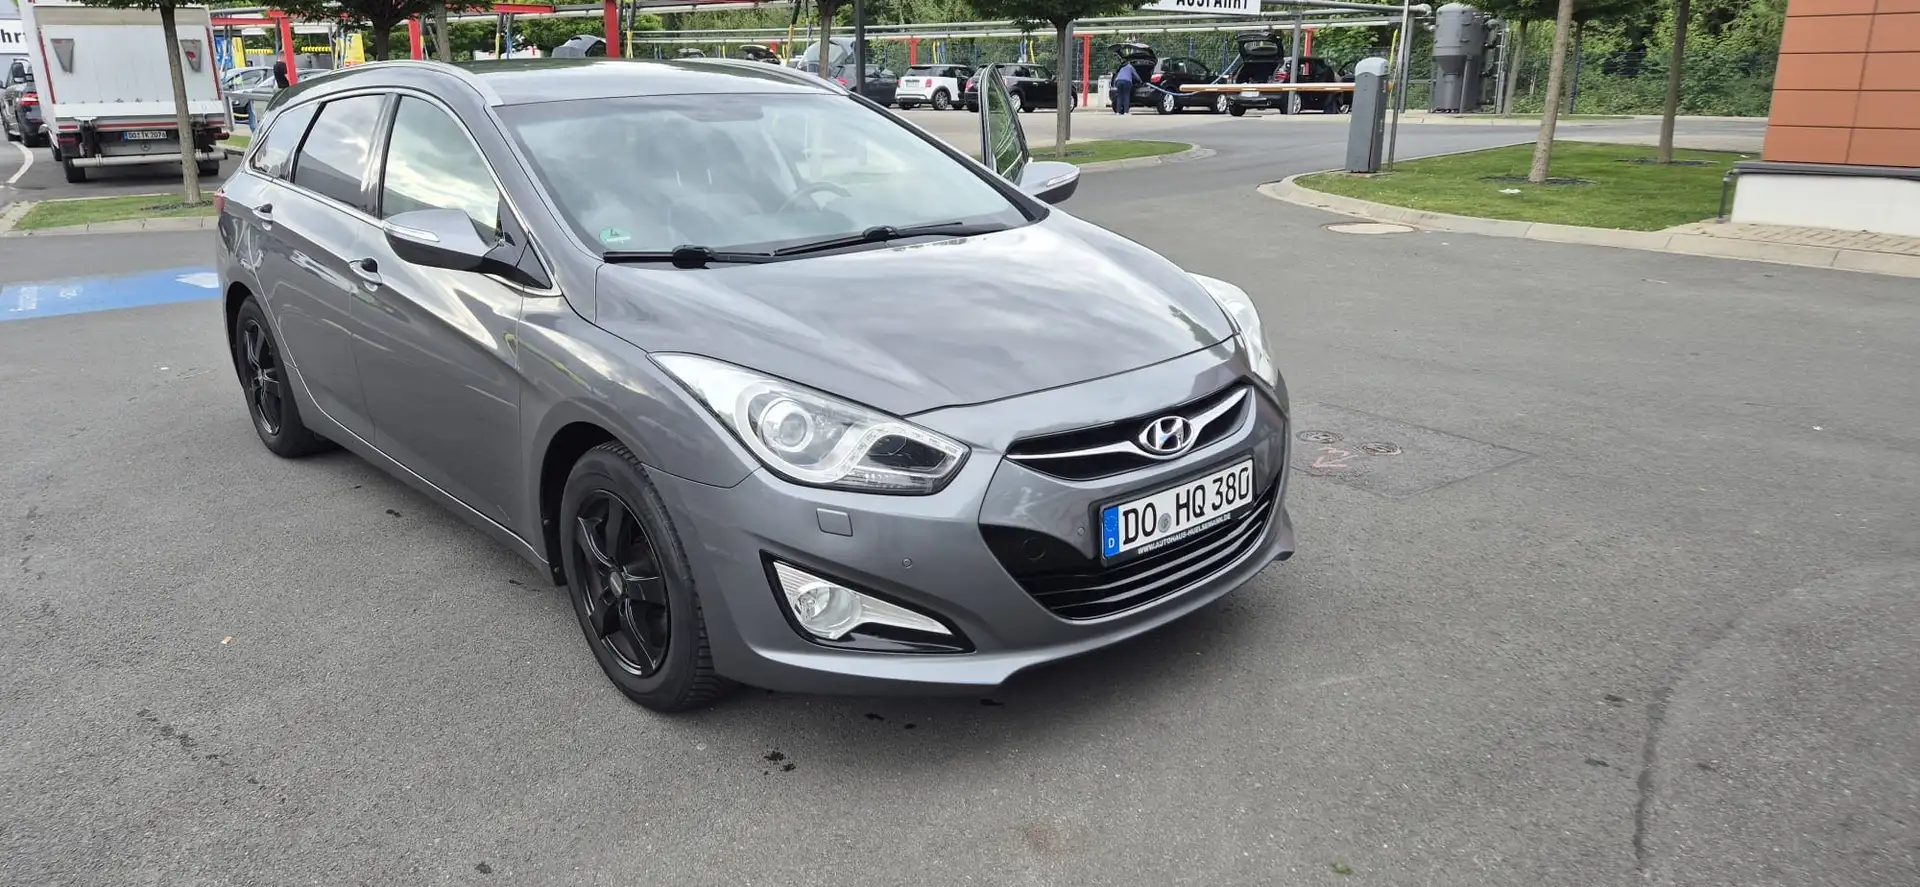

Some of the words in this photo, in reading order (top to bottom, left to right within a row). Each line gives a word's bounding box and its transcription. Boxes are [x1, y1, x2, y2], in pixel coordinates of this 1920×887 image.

[1122, 502, 1157, 545] DO
[1175, 484, 1206, 526] HQ
[1211, 466, 1250, 511] 380
[1108, 538, 1115, 549] D
